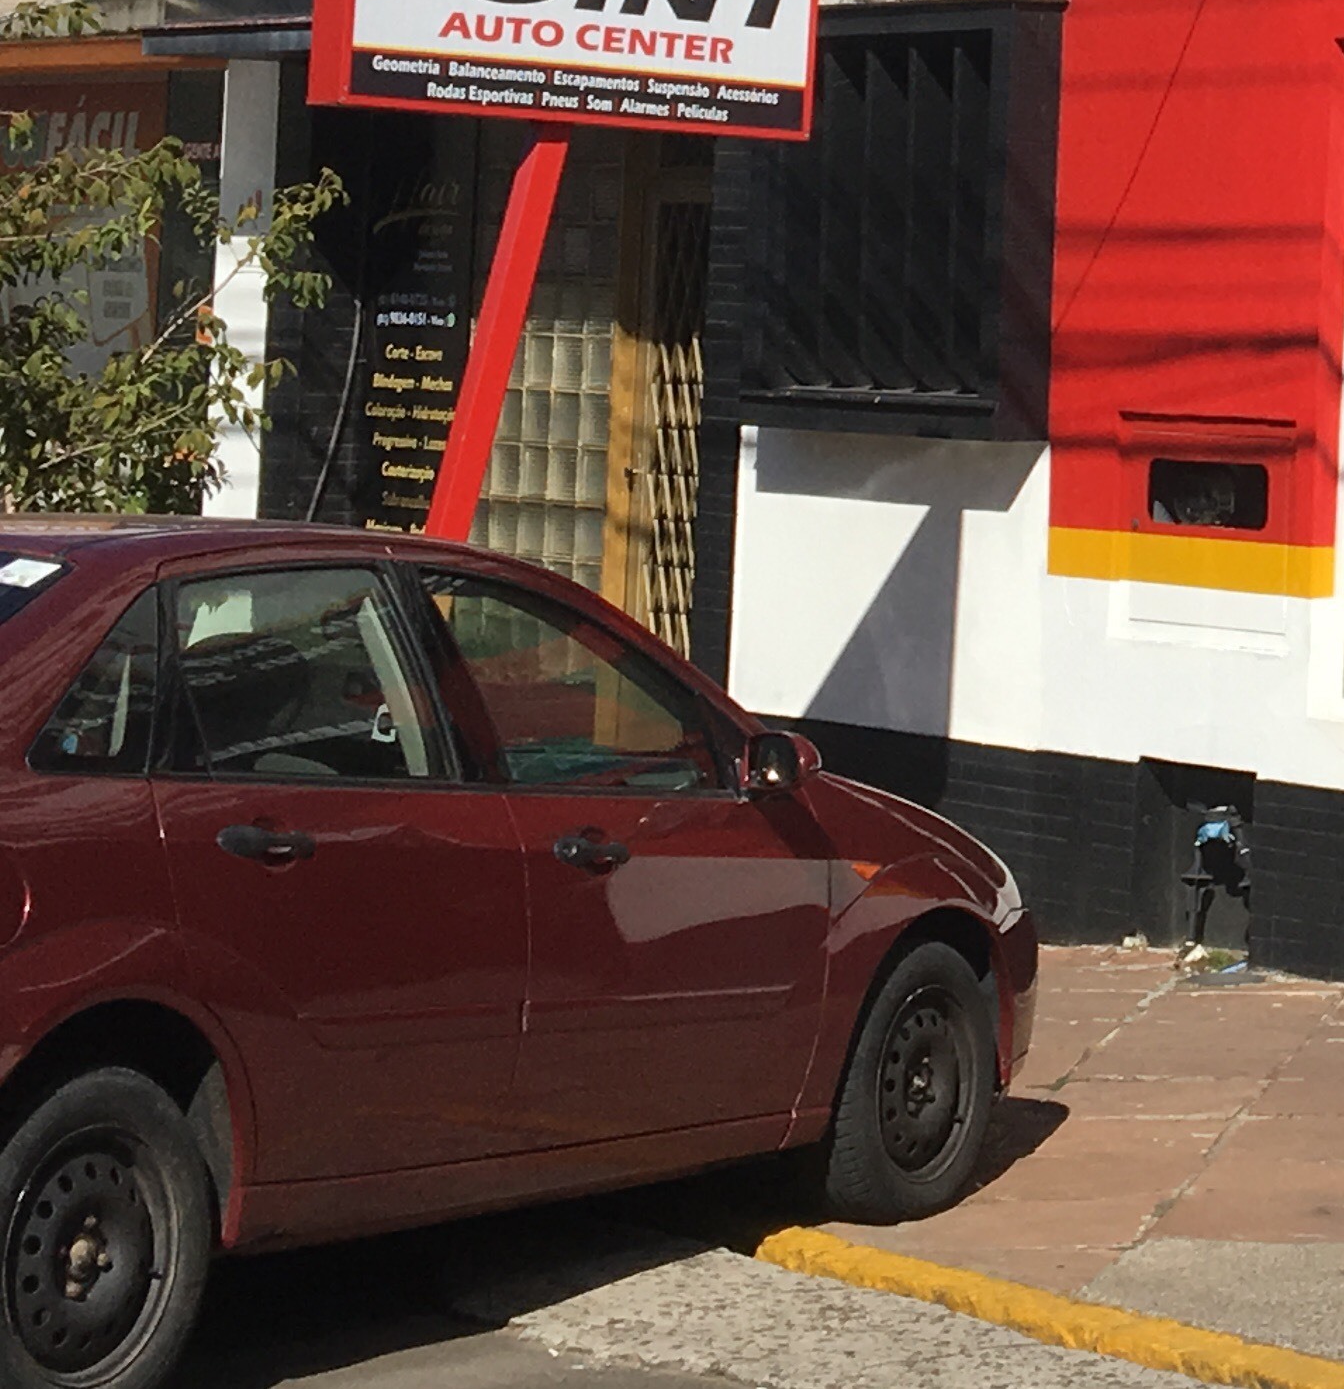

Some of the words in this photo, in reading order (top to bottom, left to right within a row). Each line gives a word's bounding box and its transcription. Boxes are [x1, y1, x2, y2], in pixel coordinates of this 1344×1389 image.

[438, 11, 564, 48] AUTO
[575, 24, 734, 65] CENTER
[372, 54, 441, 76] Geometria
[448, 61, 546, 84] Balanceamento
[553, 70, 640, 91] Escapamentos
[647, 78, 710, 99] Suspensão
[716, 85, 780, 105] Acessórios
[427, 82, 466, 100] Rodas
[468, 85, 534, 106] Esportivas
[541, 91, 579, 109] Pneus
[586, 94, 612, 112] Som
[620, 98, 670, 116] Alarmes
